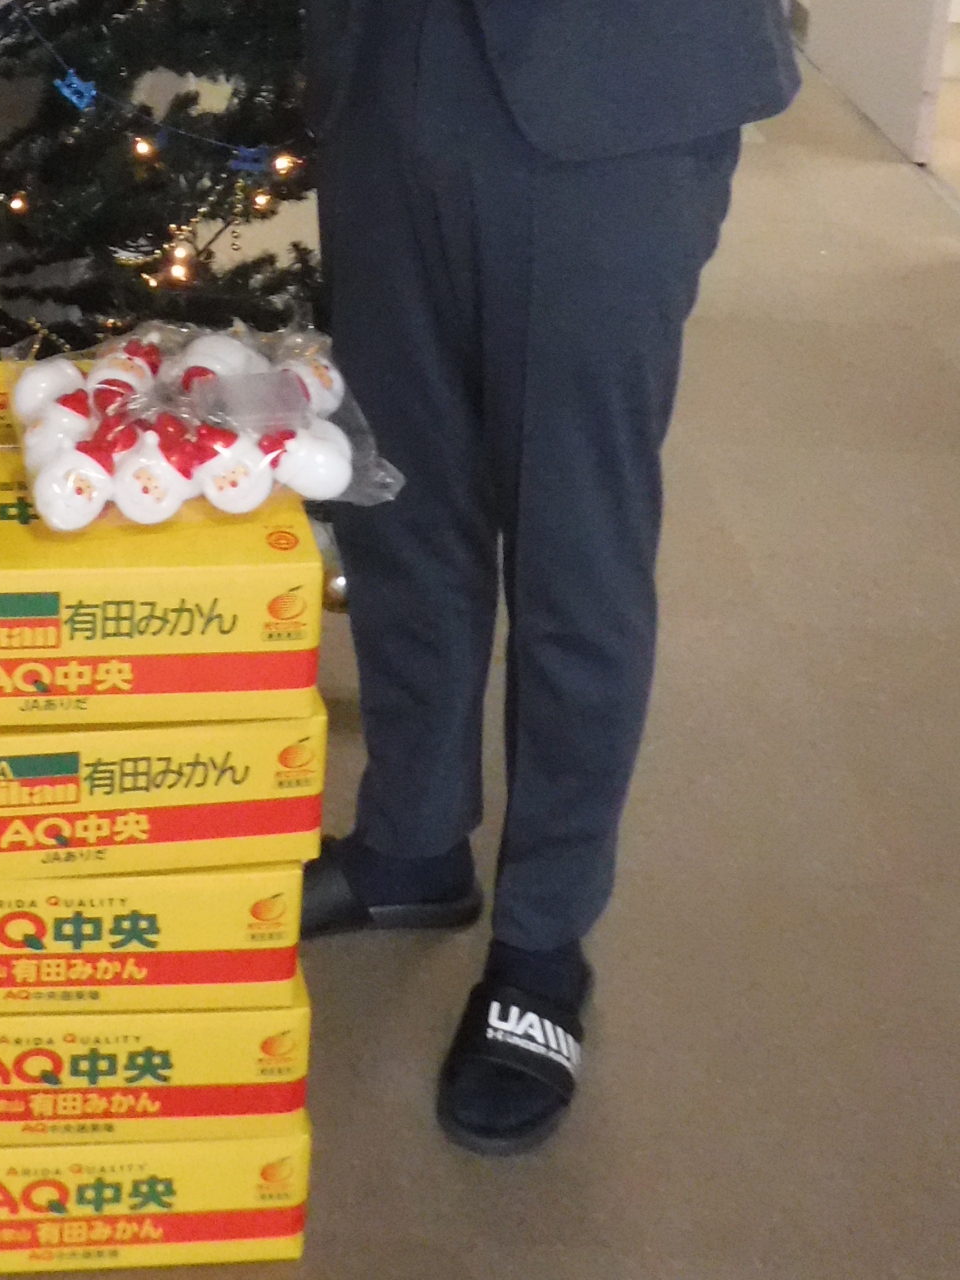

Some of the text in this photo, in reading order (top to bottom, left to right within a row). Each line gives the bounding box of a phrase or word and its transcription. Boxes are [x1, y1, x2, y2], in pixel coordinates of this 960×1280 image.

[63, 598, 239, 640] 有田みかん
[83, 751, 250, 795] 有田みかん
[46, 895, 128, 908] QUALITY
[10, 958, 149, 984] 有田みかん
[62, 1032, 141, 1045] QUALITY
[28, 1092, 162, 1118] 有田みかん
[36, 1219, 164, 1246] 有田みかん
